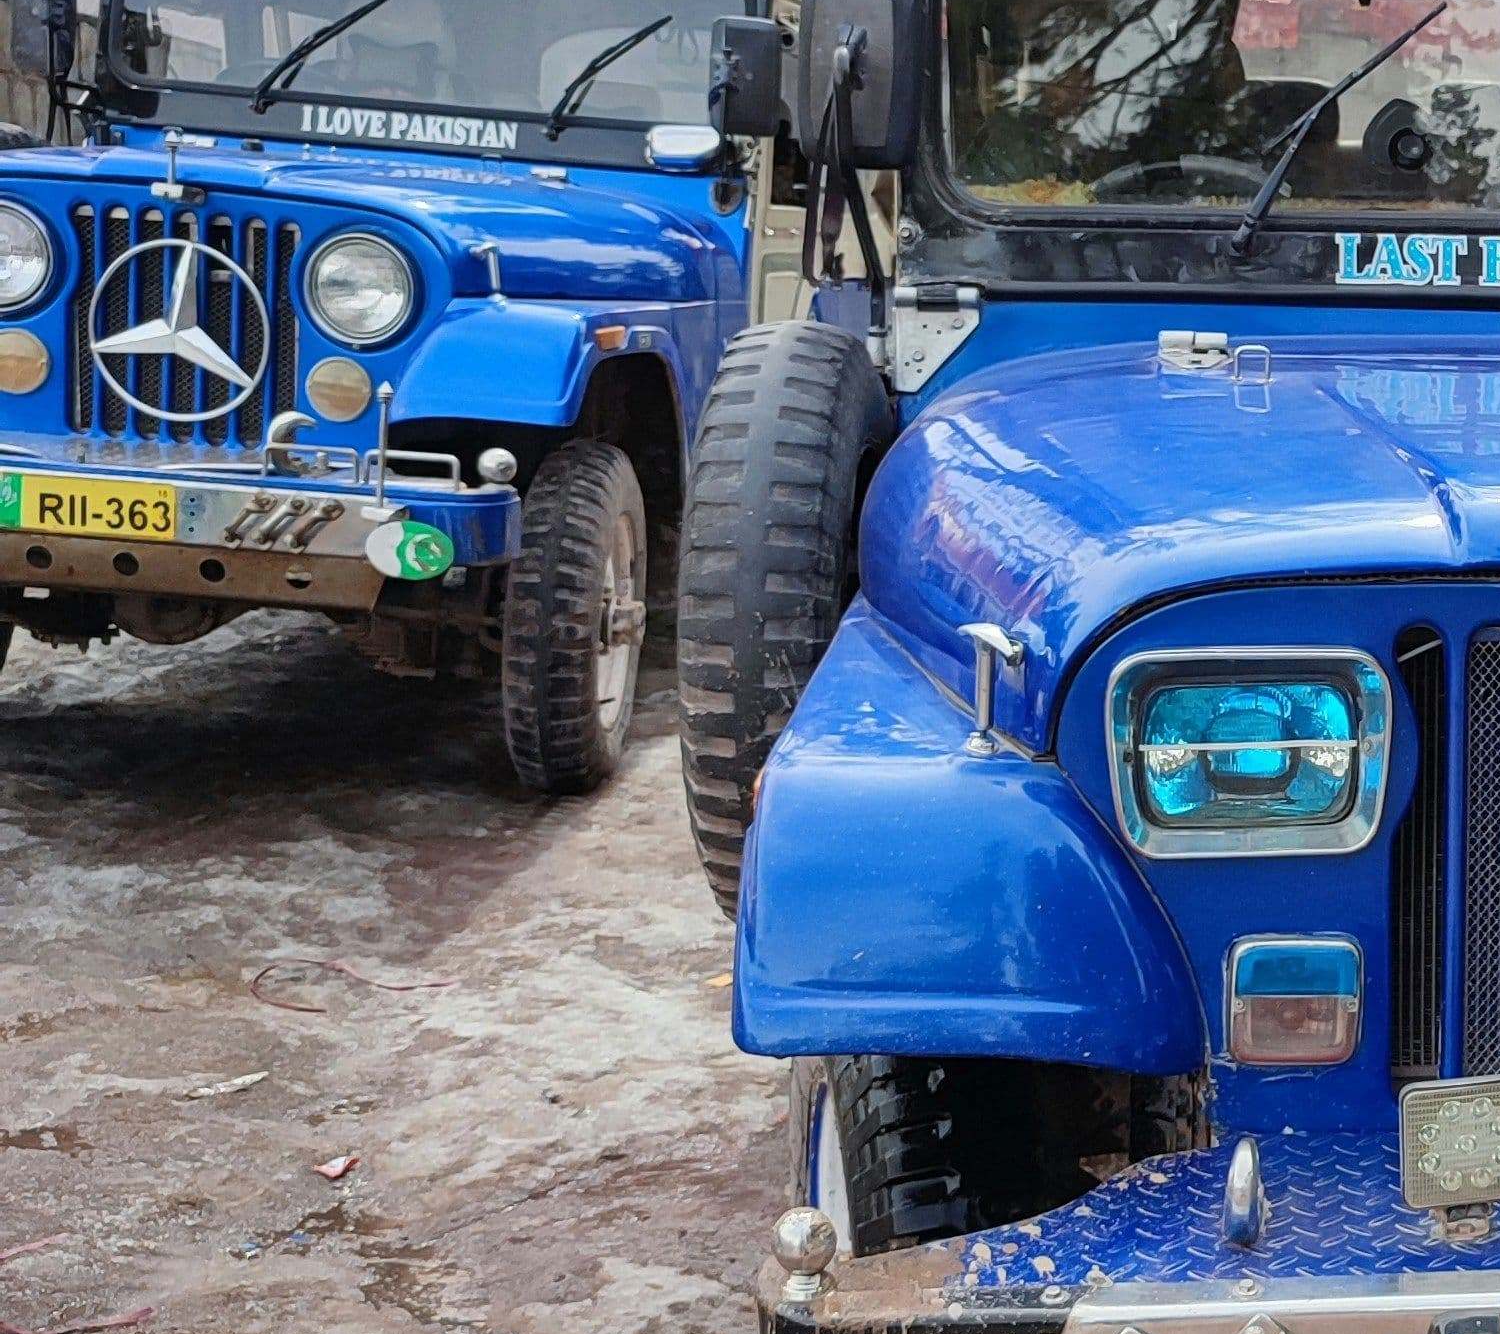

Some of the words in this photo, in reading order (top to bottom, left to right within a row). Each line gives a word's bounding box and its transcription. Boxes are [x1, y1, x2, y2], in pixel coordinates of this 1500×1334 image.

[301, 104, 313, 132] I
[316, 105, 386, 138] LOVE
[390, 111, 519, 150] PAKISTAN
[1335, 233, 1467, 286] LAST
[39, 493, 171, 533] RII-363
